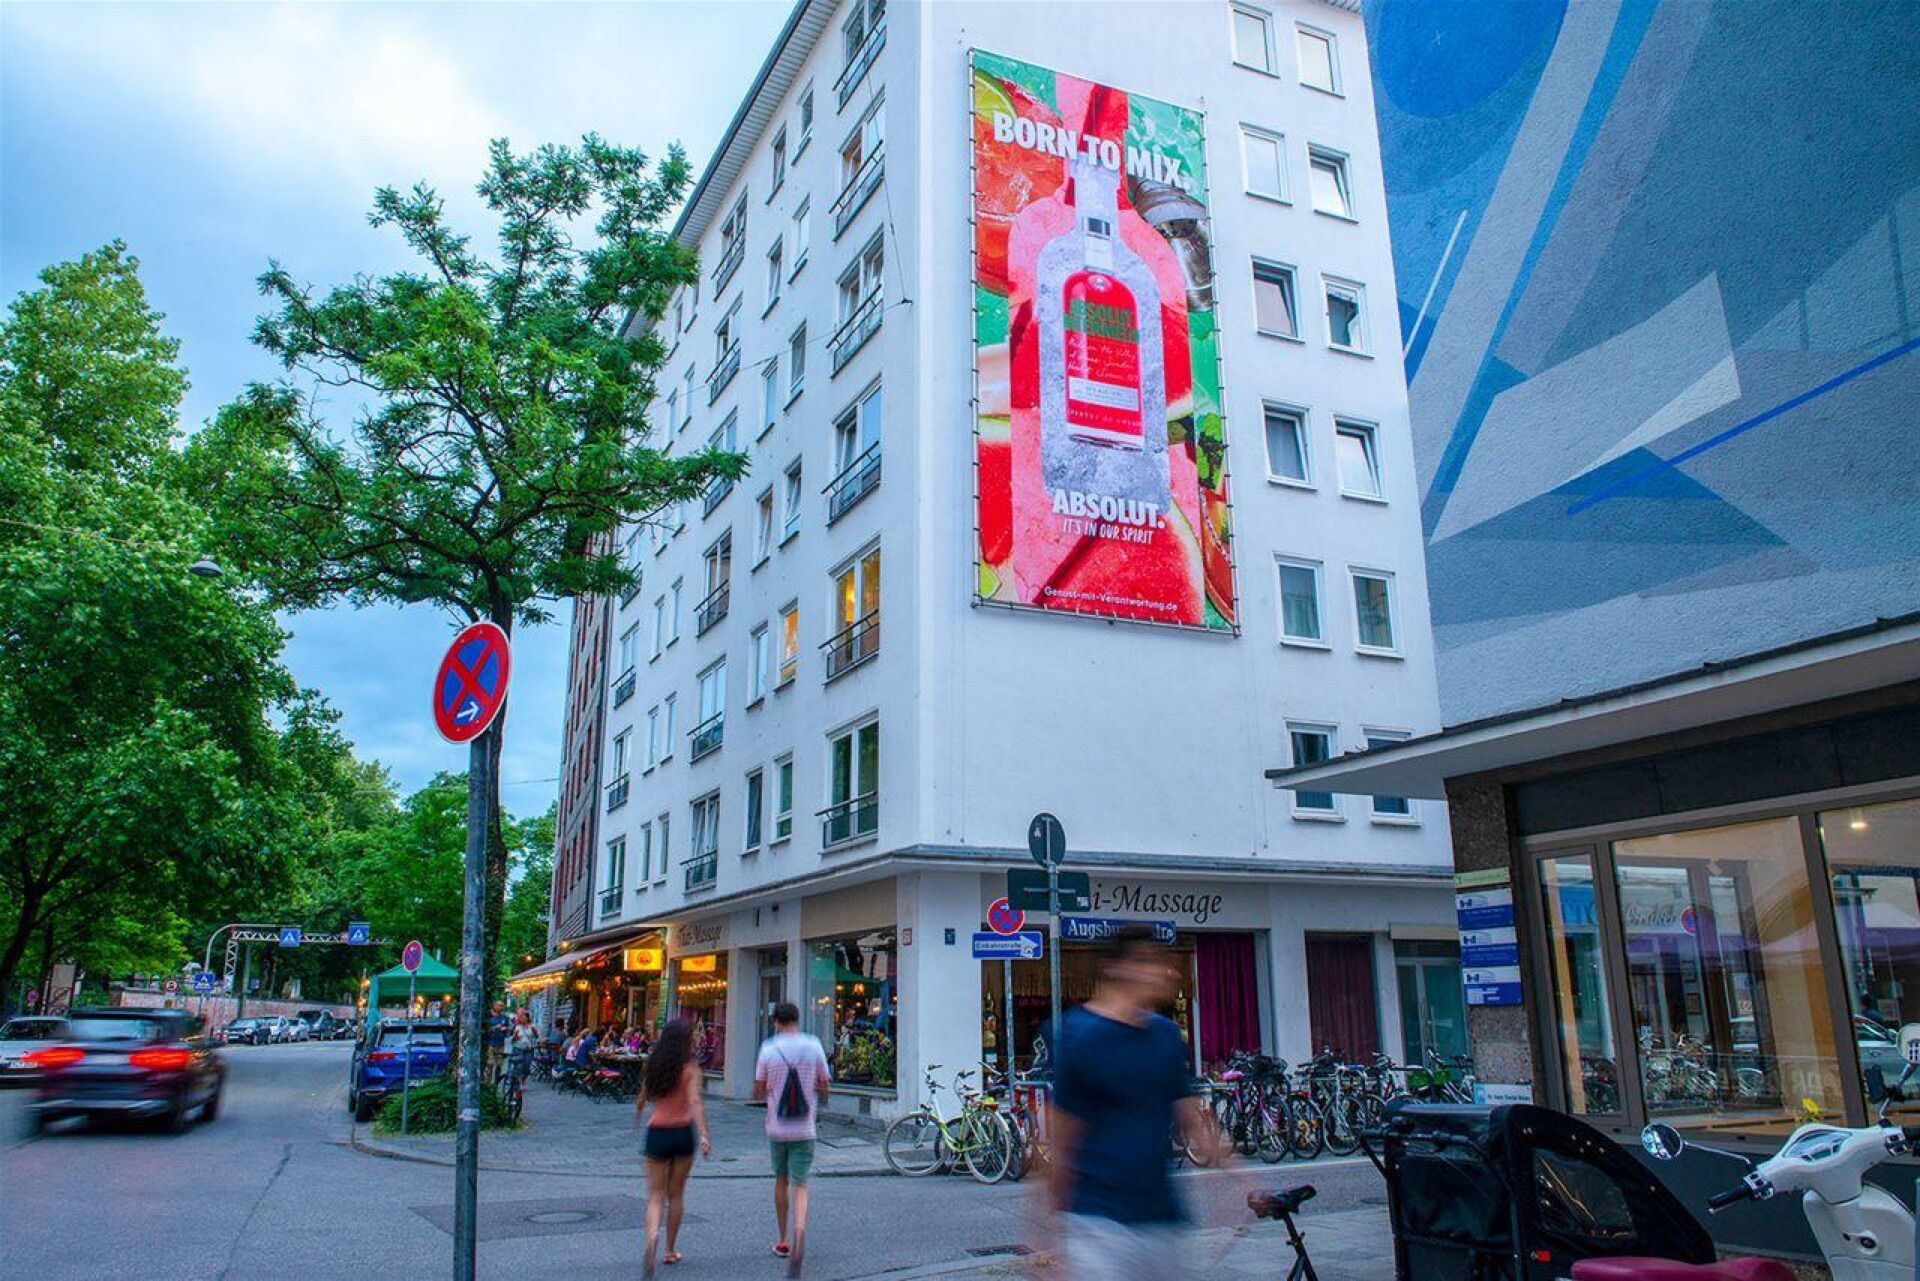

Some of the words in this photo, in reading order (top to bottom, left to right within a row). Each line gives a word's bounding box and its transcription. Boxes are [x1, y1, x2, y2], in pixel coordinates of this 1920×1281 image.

[993, 110, 1078, 160] BORN
[1083, 134, 1121, 171] TO
[1127, 146, 1191, 190] MIX.
[1052, 488, 1166, 529] ABSOLUT.
[1063, 518, 1082, 535] IT'S
[1084, 521, 1097, 537] IN
[1100, 523, 1120, 540] OUR
[1121, 526, 1155, 545] SPIRIT
[1093, 883, 1222, 924] i-Massage
